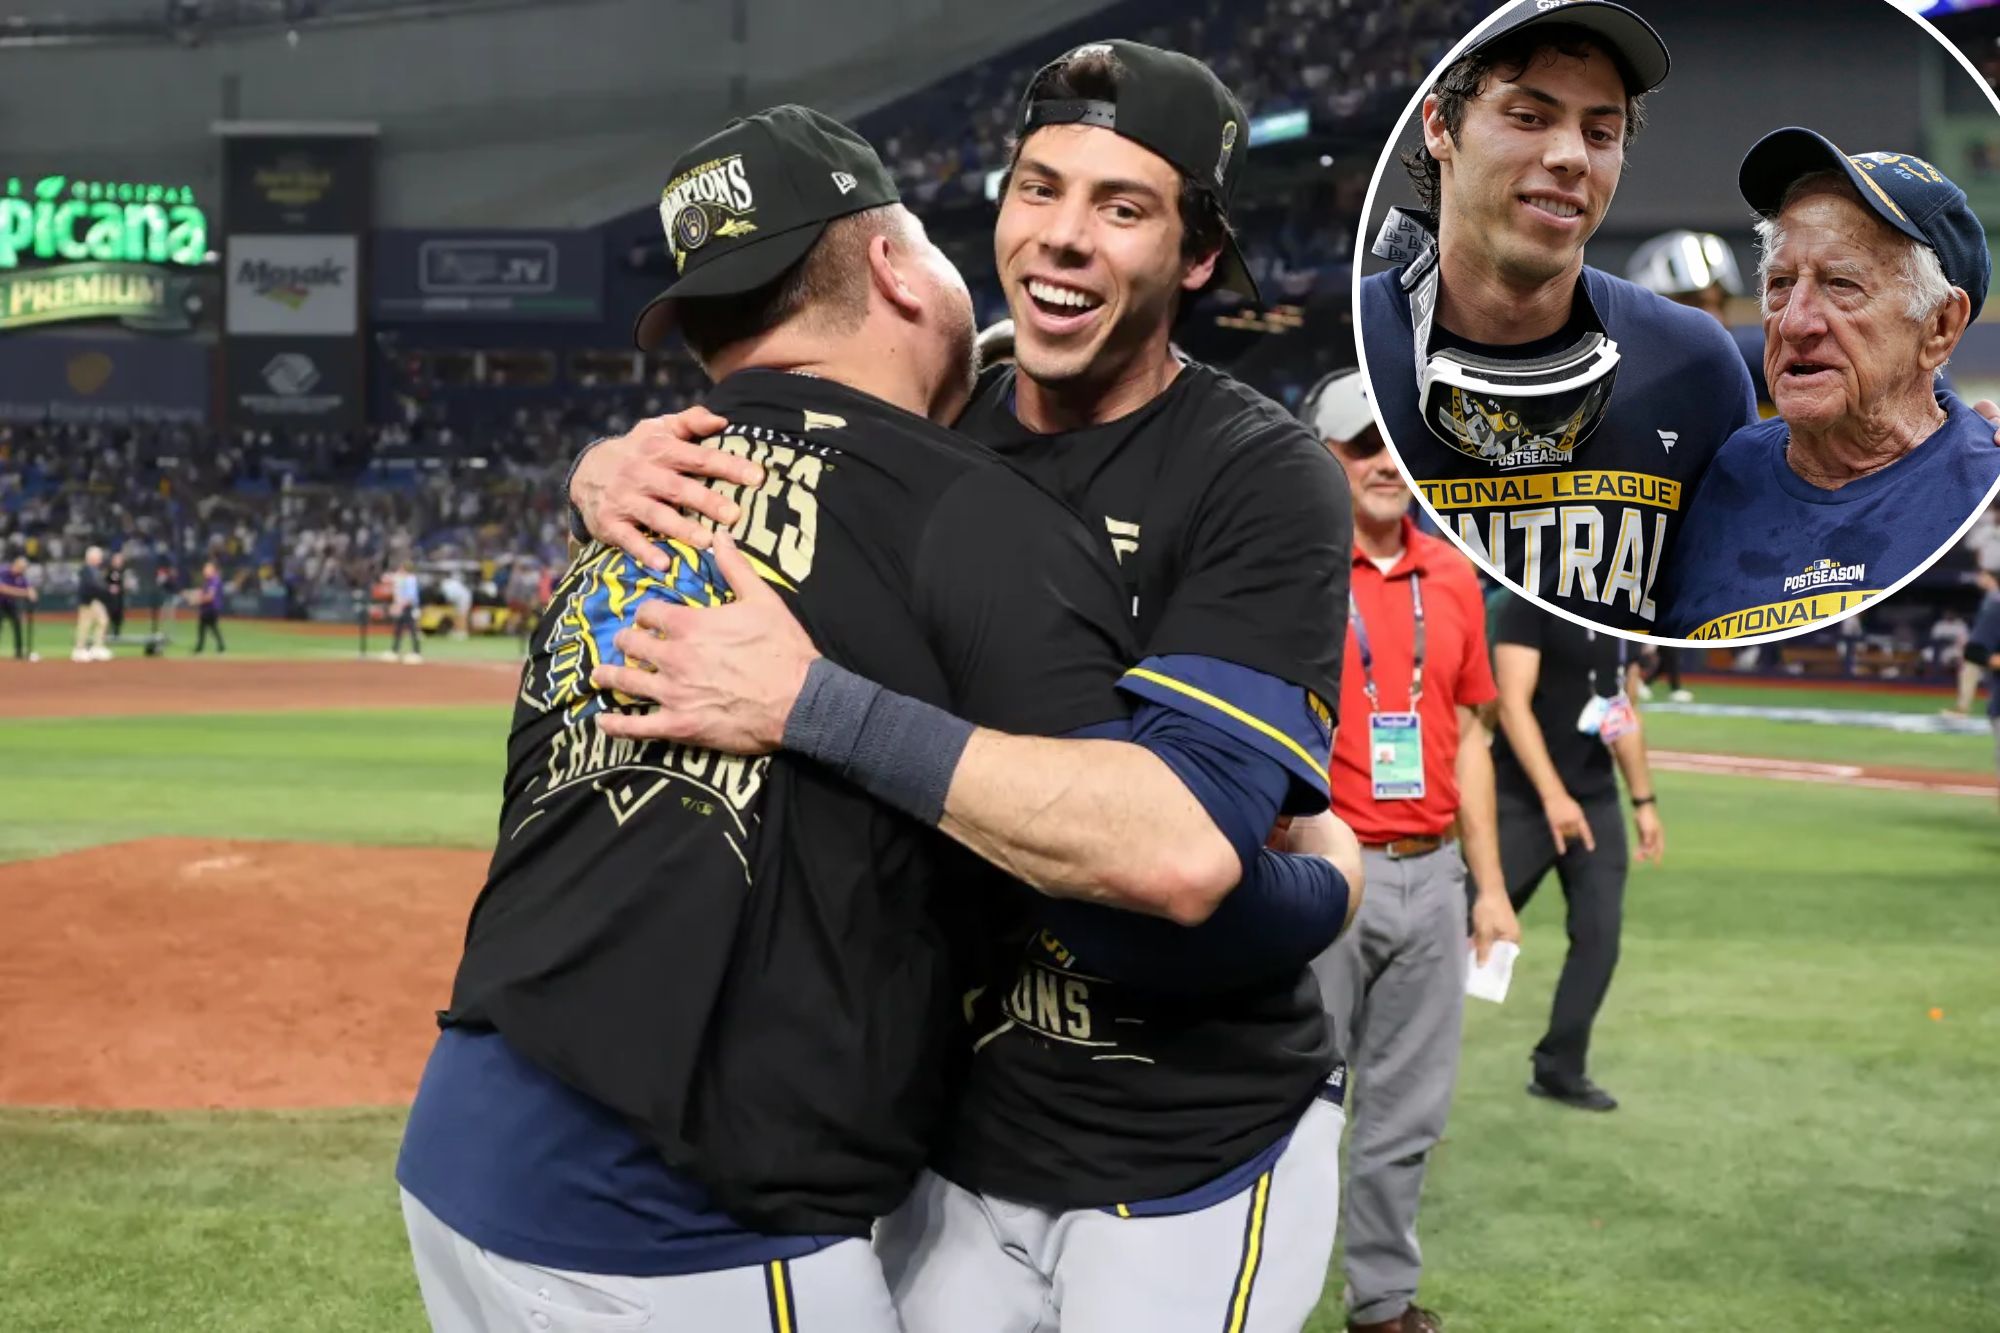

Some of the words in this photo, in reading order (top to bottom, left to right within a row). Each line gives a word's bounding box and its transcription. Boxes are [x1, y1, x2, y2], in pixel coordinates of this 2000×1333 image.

[236, 256, 347, 290] Mosaic
[9, 273, 164, 315] PREMIUM
[1419, 480, 1542, 504] TIONAL
[1553, 474, 1677, 504] LEAGUE
[1446, 505, 1667, 622] NTRAL
[1783, 563, 1865, 592] POSTSEASON
